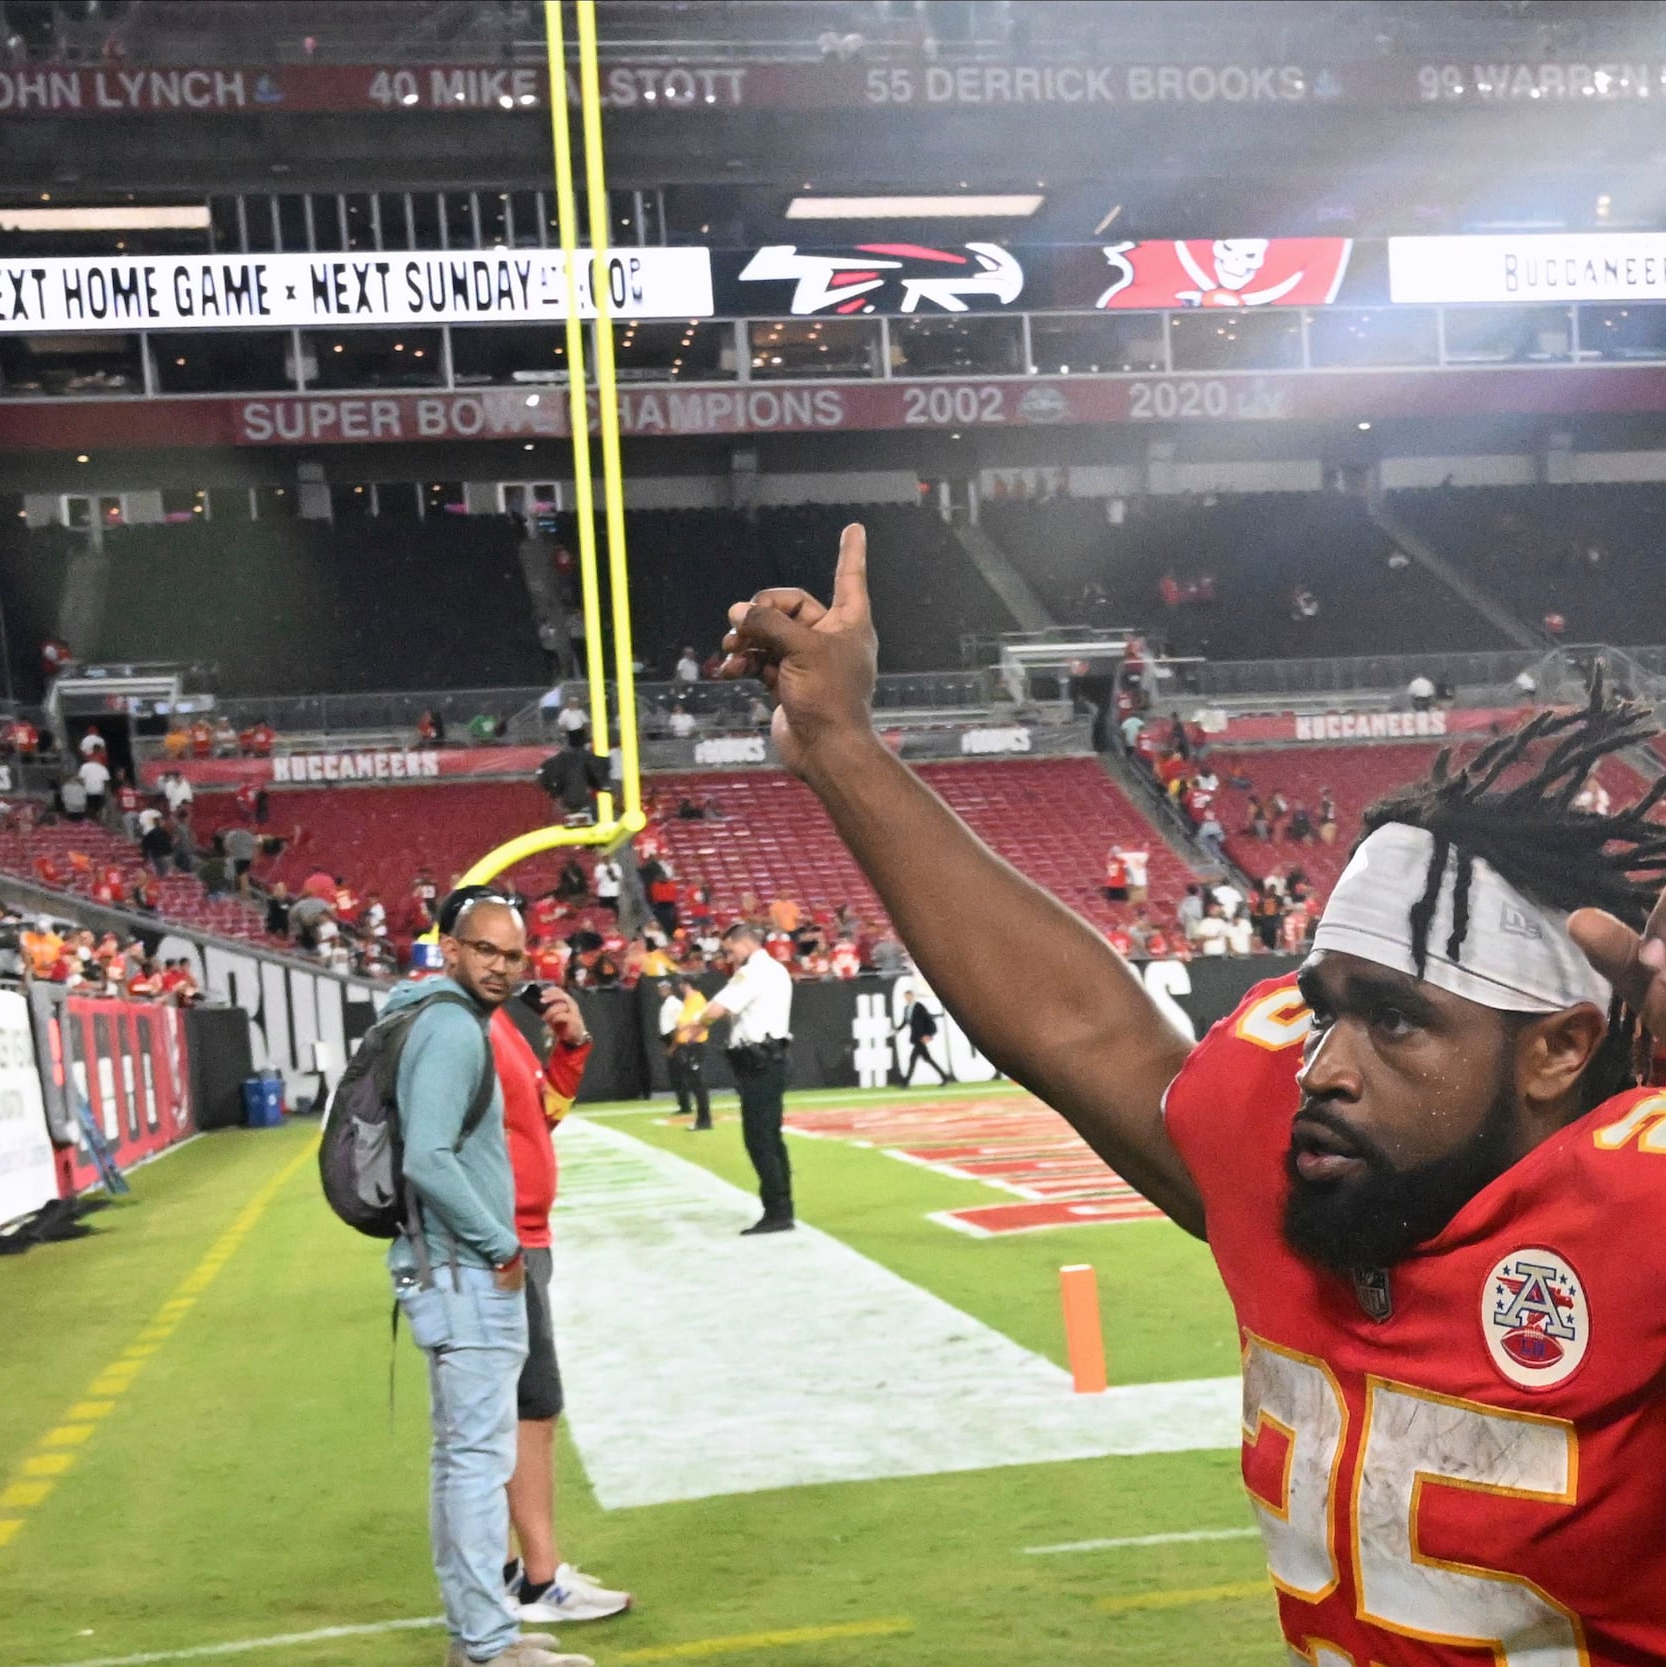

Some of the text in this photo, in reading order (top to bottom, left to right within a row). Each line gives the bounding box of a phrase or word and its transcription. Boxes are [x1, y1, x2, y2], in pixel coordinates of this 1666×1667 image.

[95, 70, 246, 108] LYNCH
[369, 67, 747, 107] 40 MIKE ASTOTT
[864, 66, 1306, 103] 55 DERRICK BROOKS
[1417, 65, 1462, 100] 99
[1473, 64, 1650, 99] WARREN
[63, 267, 160, 319] HOME
[174, 265, 271, 317] GAME
[310, 262, 390, 314] NEXT
[405, 259, 531, 313] SUNDAY
[244, 400, 403, 441] SUPER
[903, 386, 1007, 425] 2002
[1129, 380, 1229, 418] 2020
[1295, 710, 1447, 740] BUCCANEERS
[273, 751, 439, 782] BUCCANEERS
[1493, 1261, 1576, 1342] A
